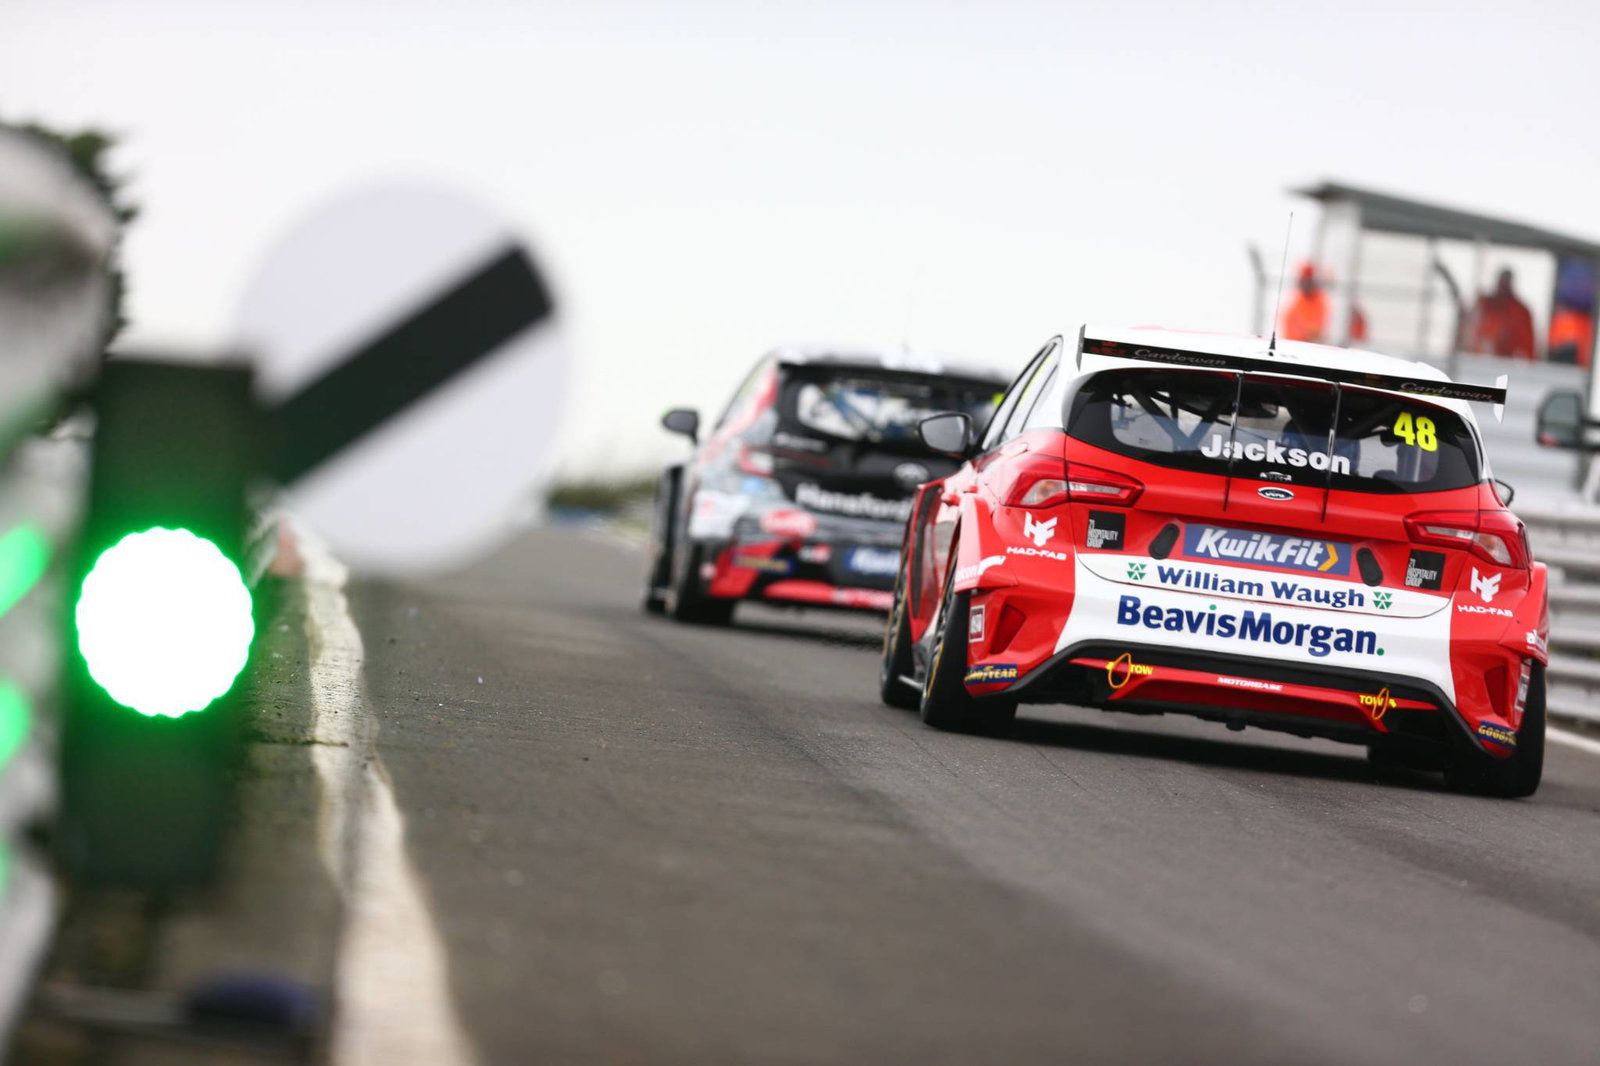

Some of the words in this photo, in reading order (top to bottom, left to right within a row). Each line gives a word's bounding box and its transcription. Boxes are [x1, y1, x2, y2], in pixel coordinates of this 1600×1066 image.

[1393, 412, 1437, 452] 48
[1201, 434, 1350, 474] Jackson
[1006, 546, 1067, 560] HAD-FAB
[1195, 528, 1324, 567] KwikFit
[1157, 565, 1264, 596] William
[1270, 580, 1365, 608] Waugh
[1457, 604, 1514, 617] HAD-FAB
[1130, 664, 1153, 675] TOW
[1217, 676, 1283, 691] MOTORBASE
[1360, 694, 1384, 706] TOW
